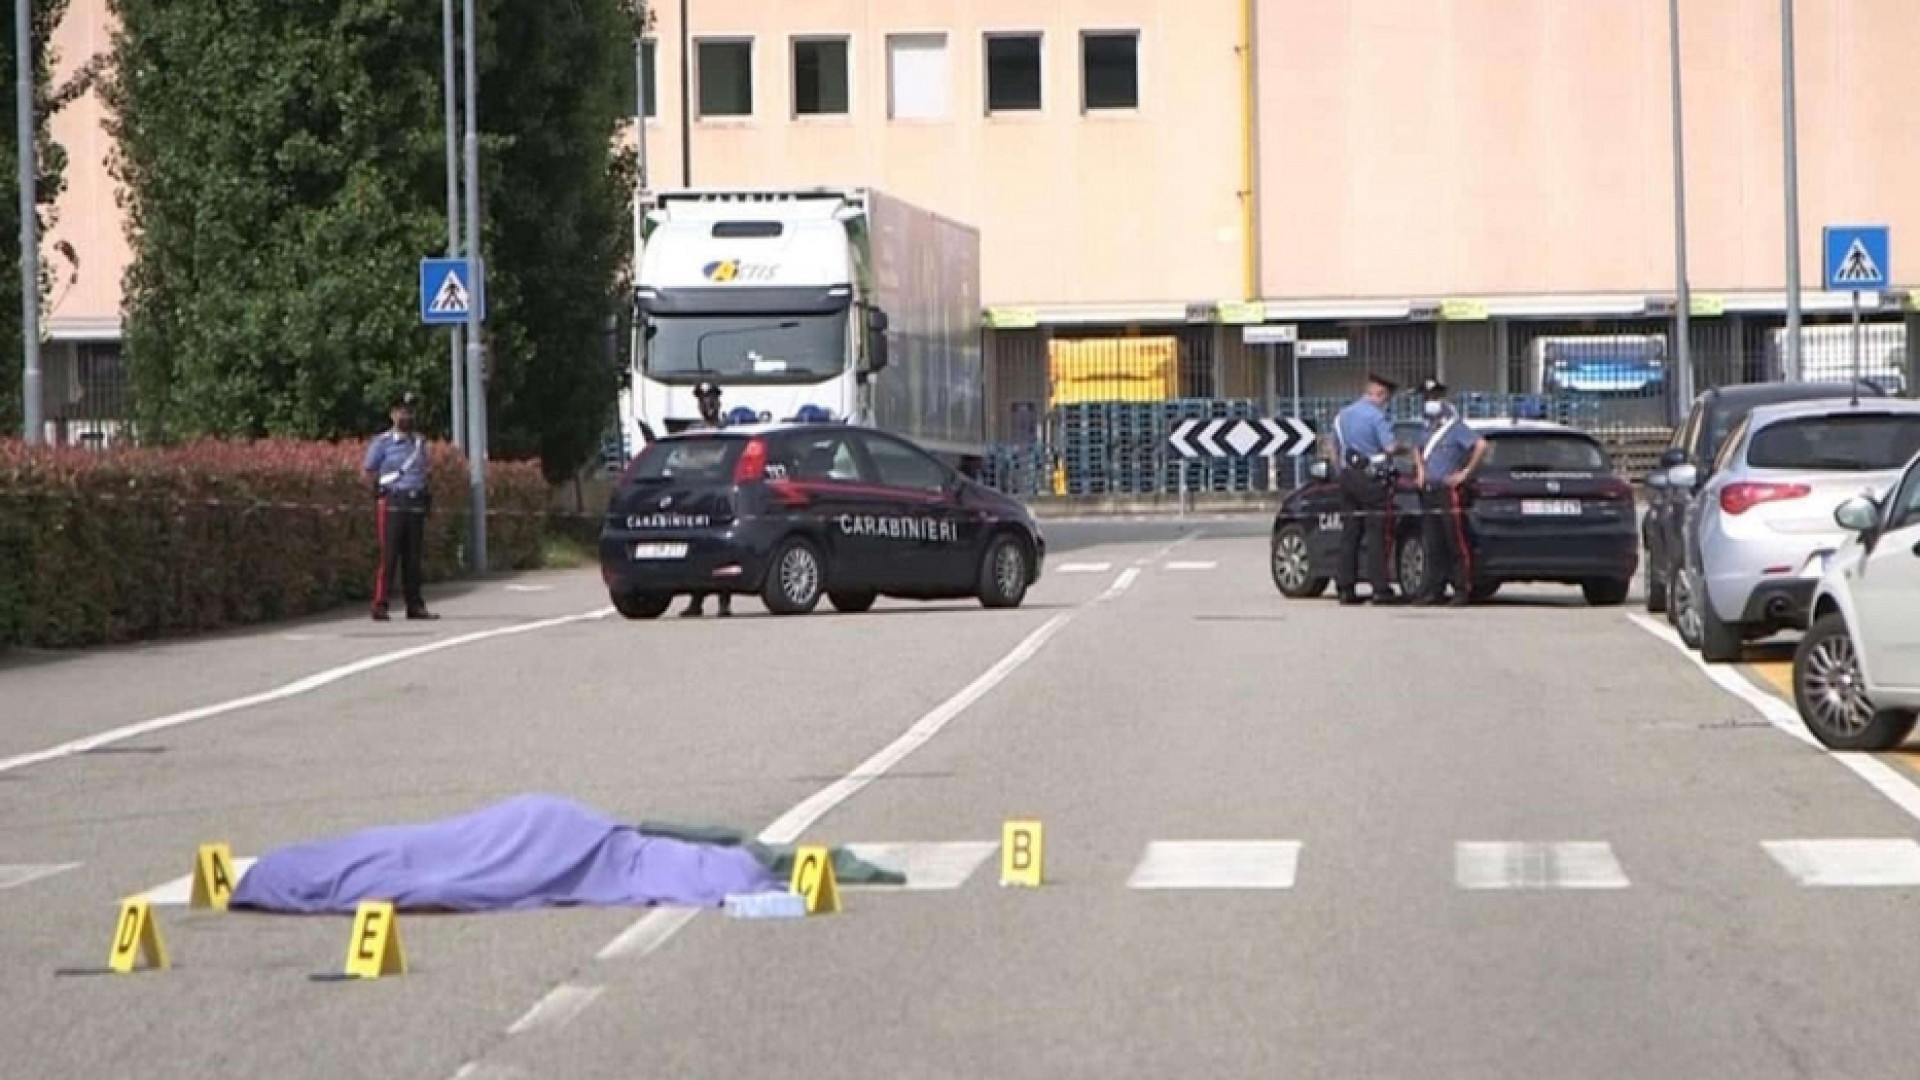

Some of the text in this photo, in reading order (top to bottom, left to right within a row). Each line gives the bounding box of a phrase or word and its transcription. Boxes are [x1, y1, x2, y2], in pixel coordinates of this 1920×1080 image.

[626, 513, 711, 529] CARABINIERI
[840, 514, 959, 541] CARABINIERI
[1012, 829, 1032, 870] B
[211, 850, 233, 896] A
[798, 853, 817, 897] C
[118, 905, 140, 954] D
[357, 911, 382, 960] E
